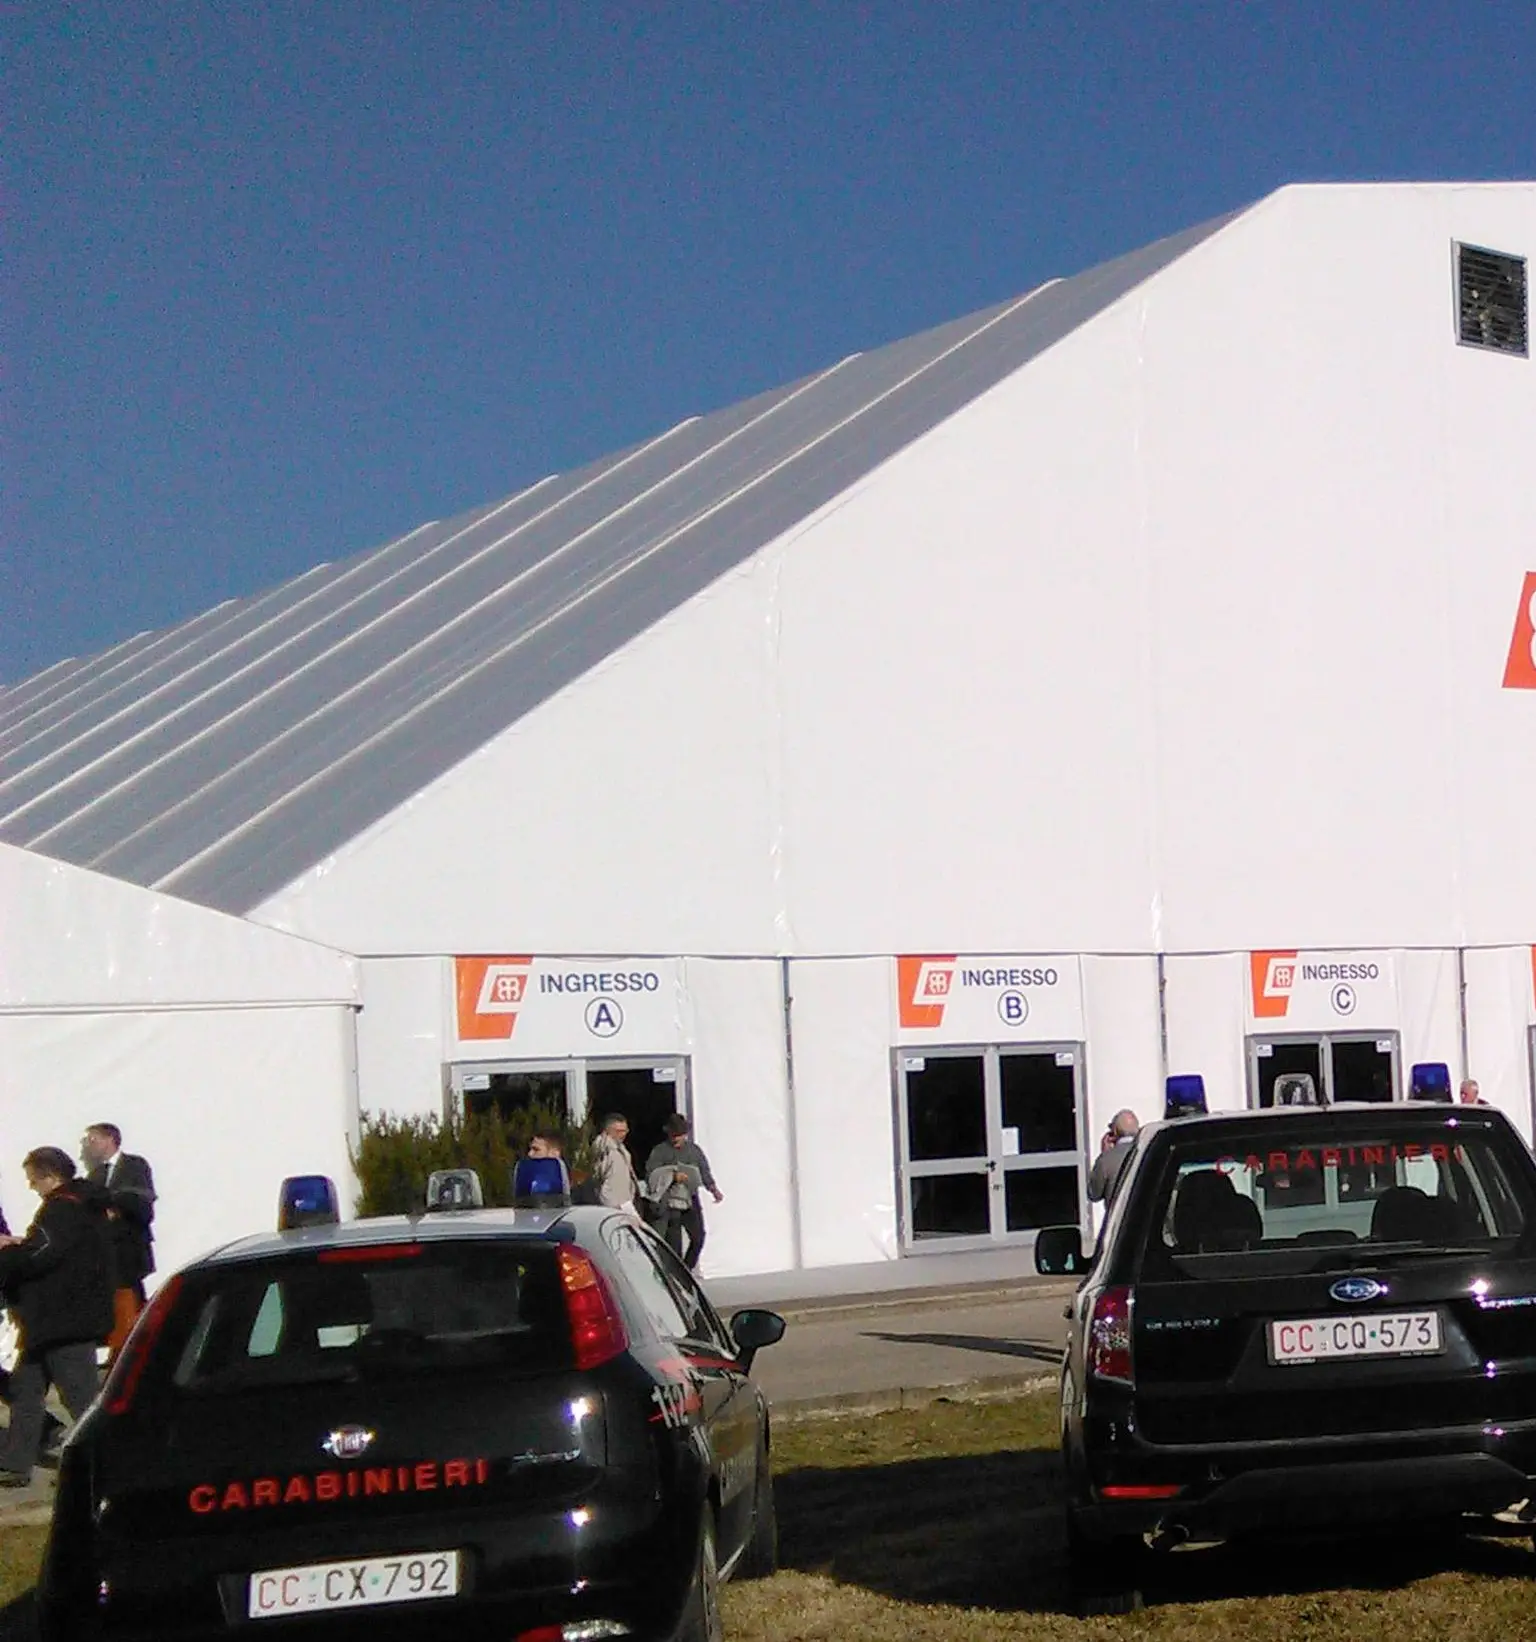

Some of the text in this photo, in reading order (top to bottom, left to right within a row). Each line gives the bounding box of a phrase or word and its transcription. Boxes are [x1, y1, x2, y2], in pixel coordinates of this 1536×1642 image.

[540, 972, 659, 993] INGRESSO
[962, 969, 1057, 986] INGRESSO
[1302, 963, 1379, 980] INGRESSO
[1006, 996, 1023, 1019] B
[1336, 988, 1351, 1010] C
[593, 1003, 616, 1029] A
[1215, 1143, 1463, 1177] CARABINIERI
[1279, 1317, 1432, 1355] CC CQ 573
[188, 1457, 489, 1514] CARABINIERI
[258, 1557, 449, 1610] CC CX 792
